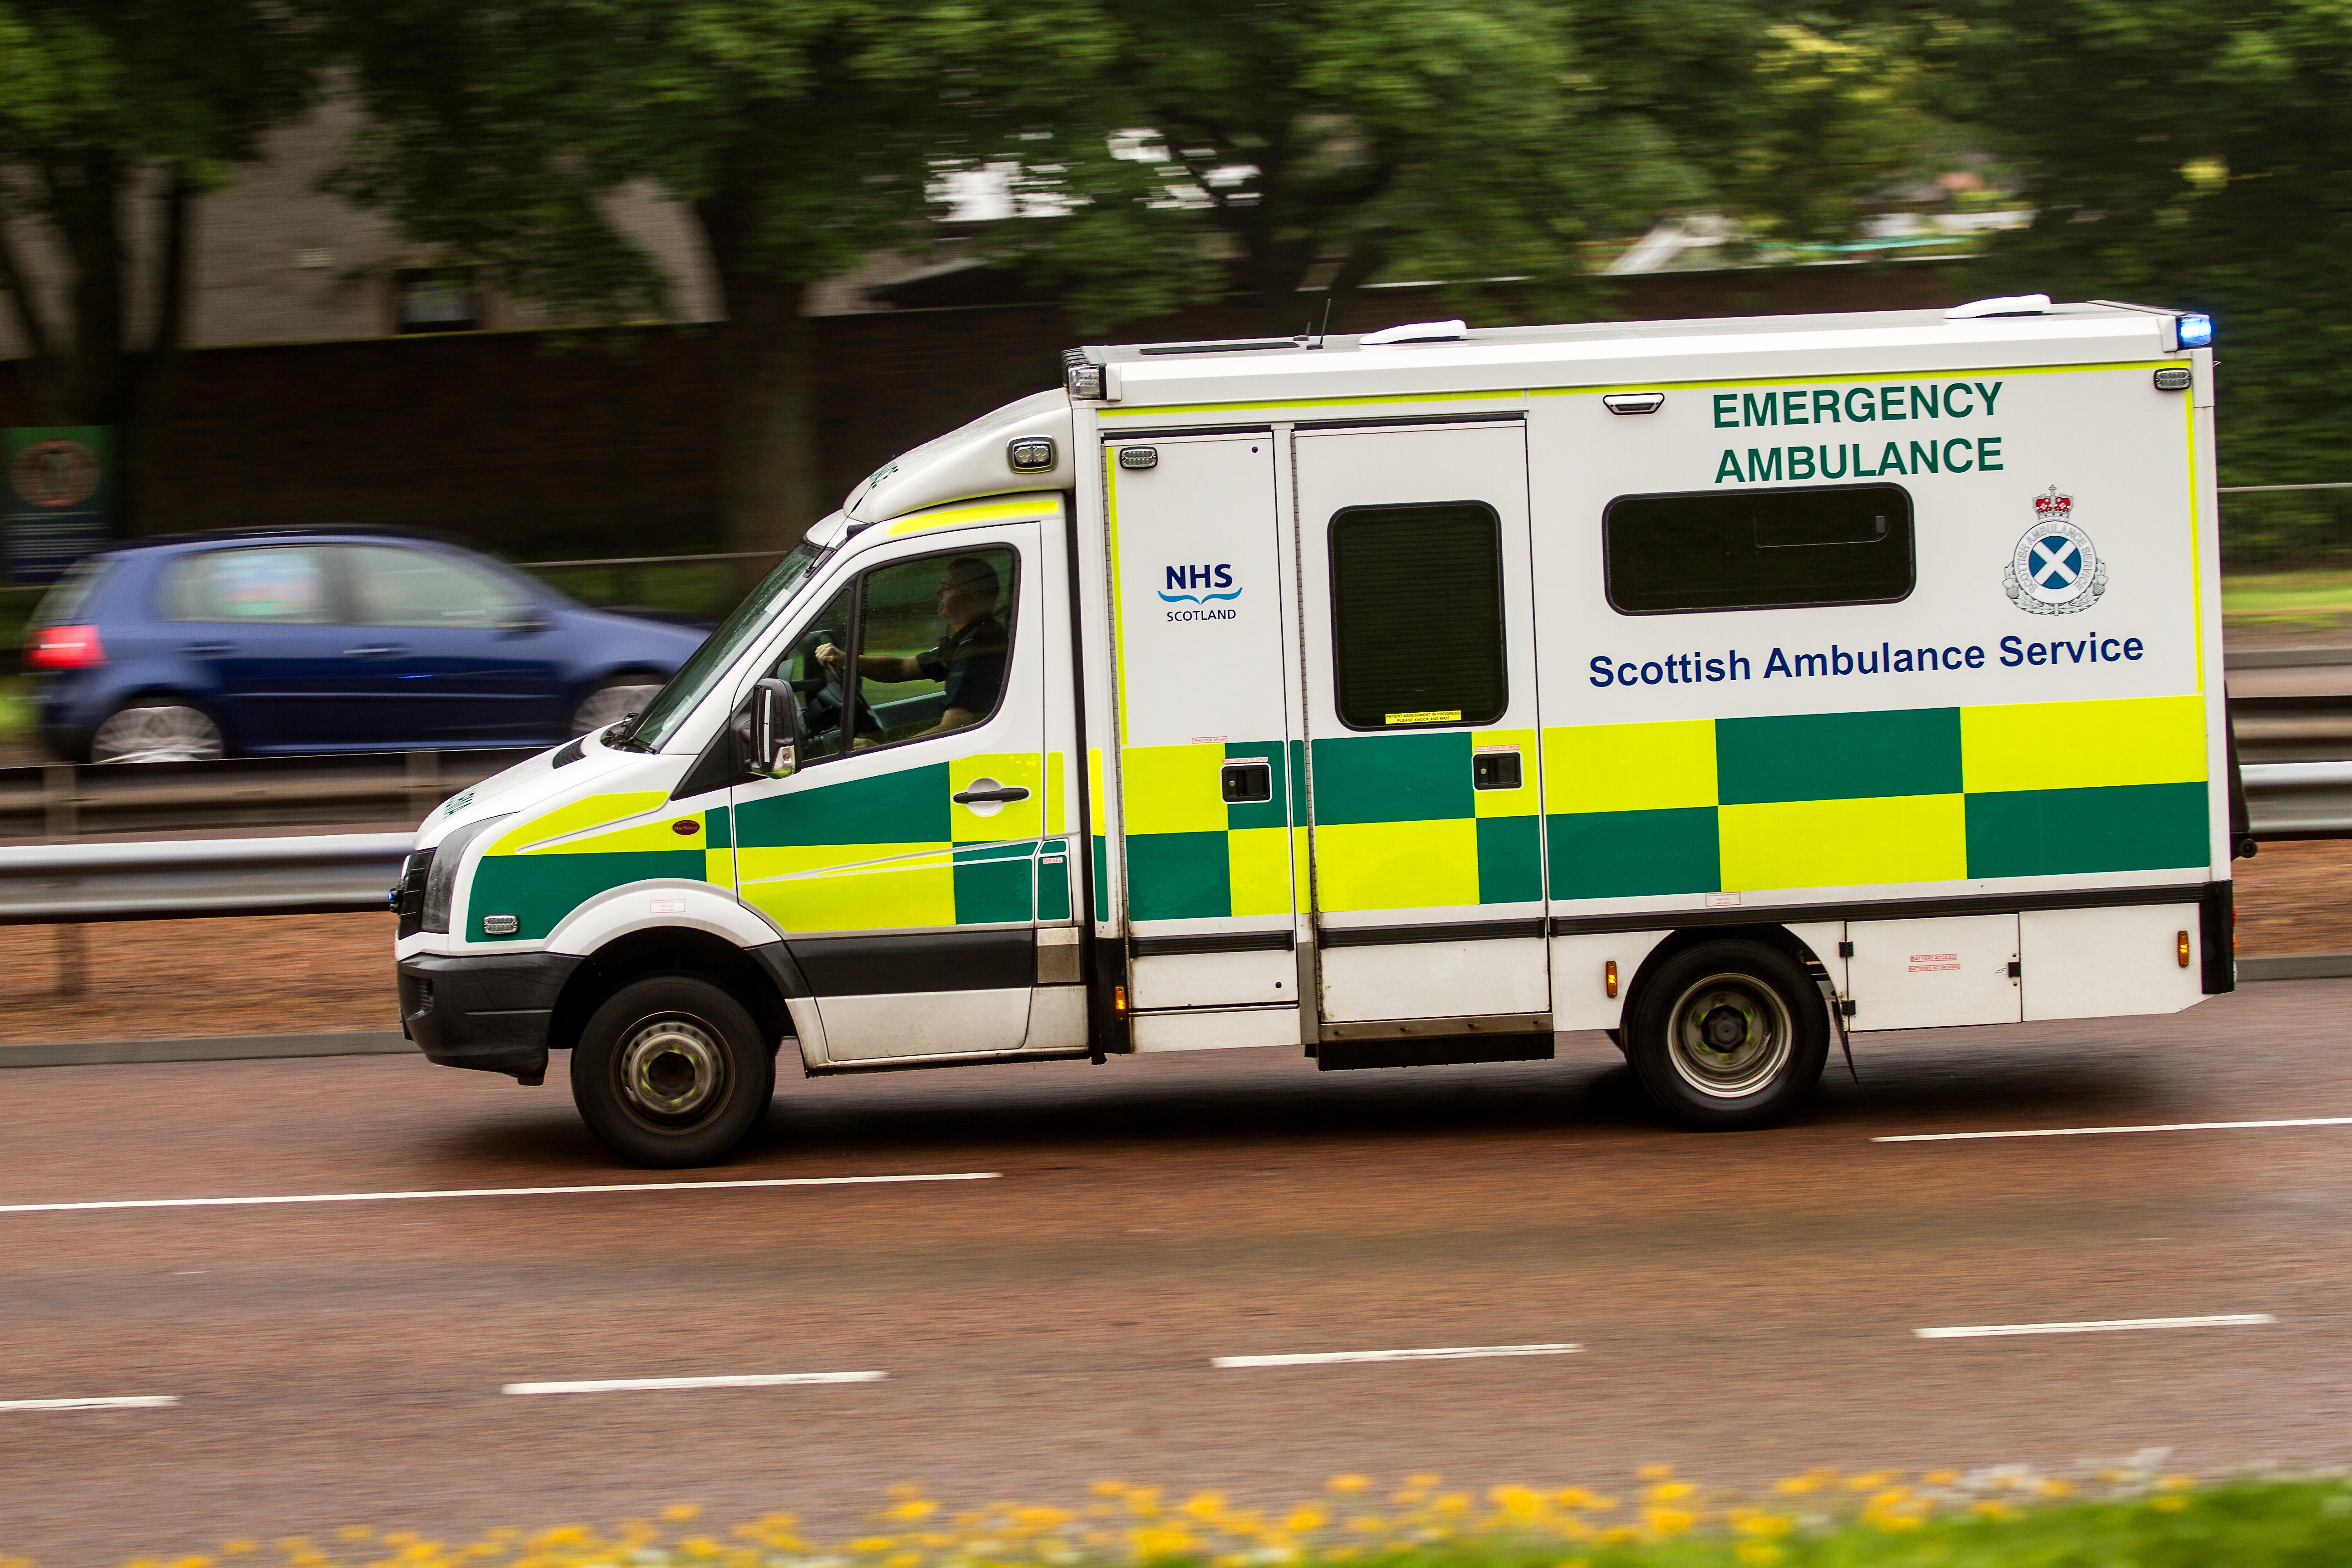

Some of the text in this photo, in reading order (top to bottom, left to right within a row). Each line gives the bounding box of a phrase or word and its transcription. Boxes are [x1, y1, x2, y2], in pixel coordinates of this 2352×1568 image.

[1713, 382, 2003, 428] EMERGENCY
[1715, 437, 2004, 484] AMBULANCE
[1166, 564, 1233, 590] NHS
[2016, 523, 2095, 593] SCOTTISH AMBULANCE SERVICE
[1167, 609, 1236, 622] SCOTLAND
[1589, 632, 2143, 687] Scottish Ambulance Service
